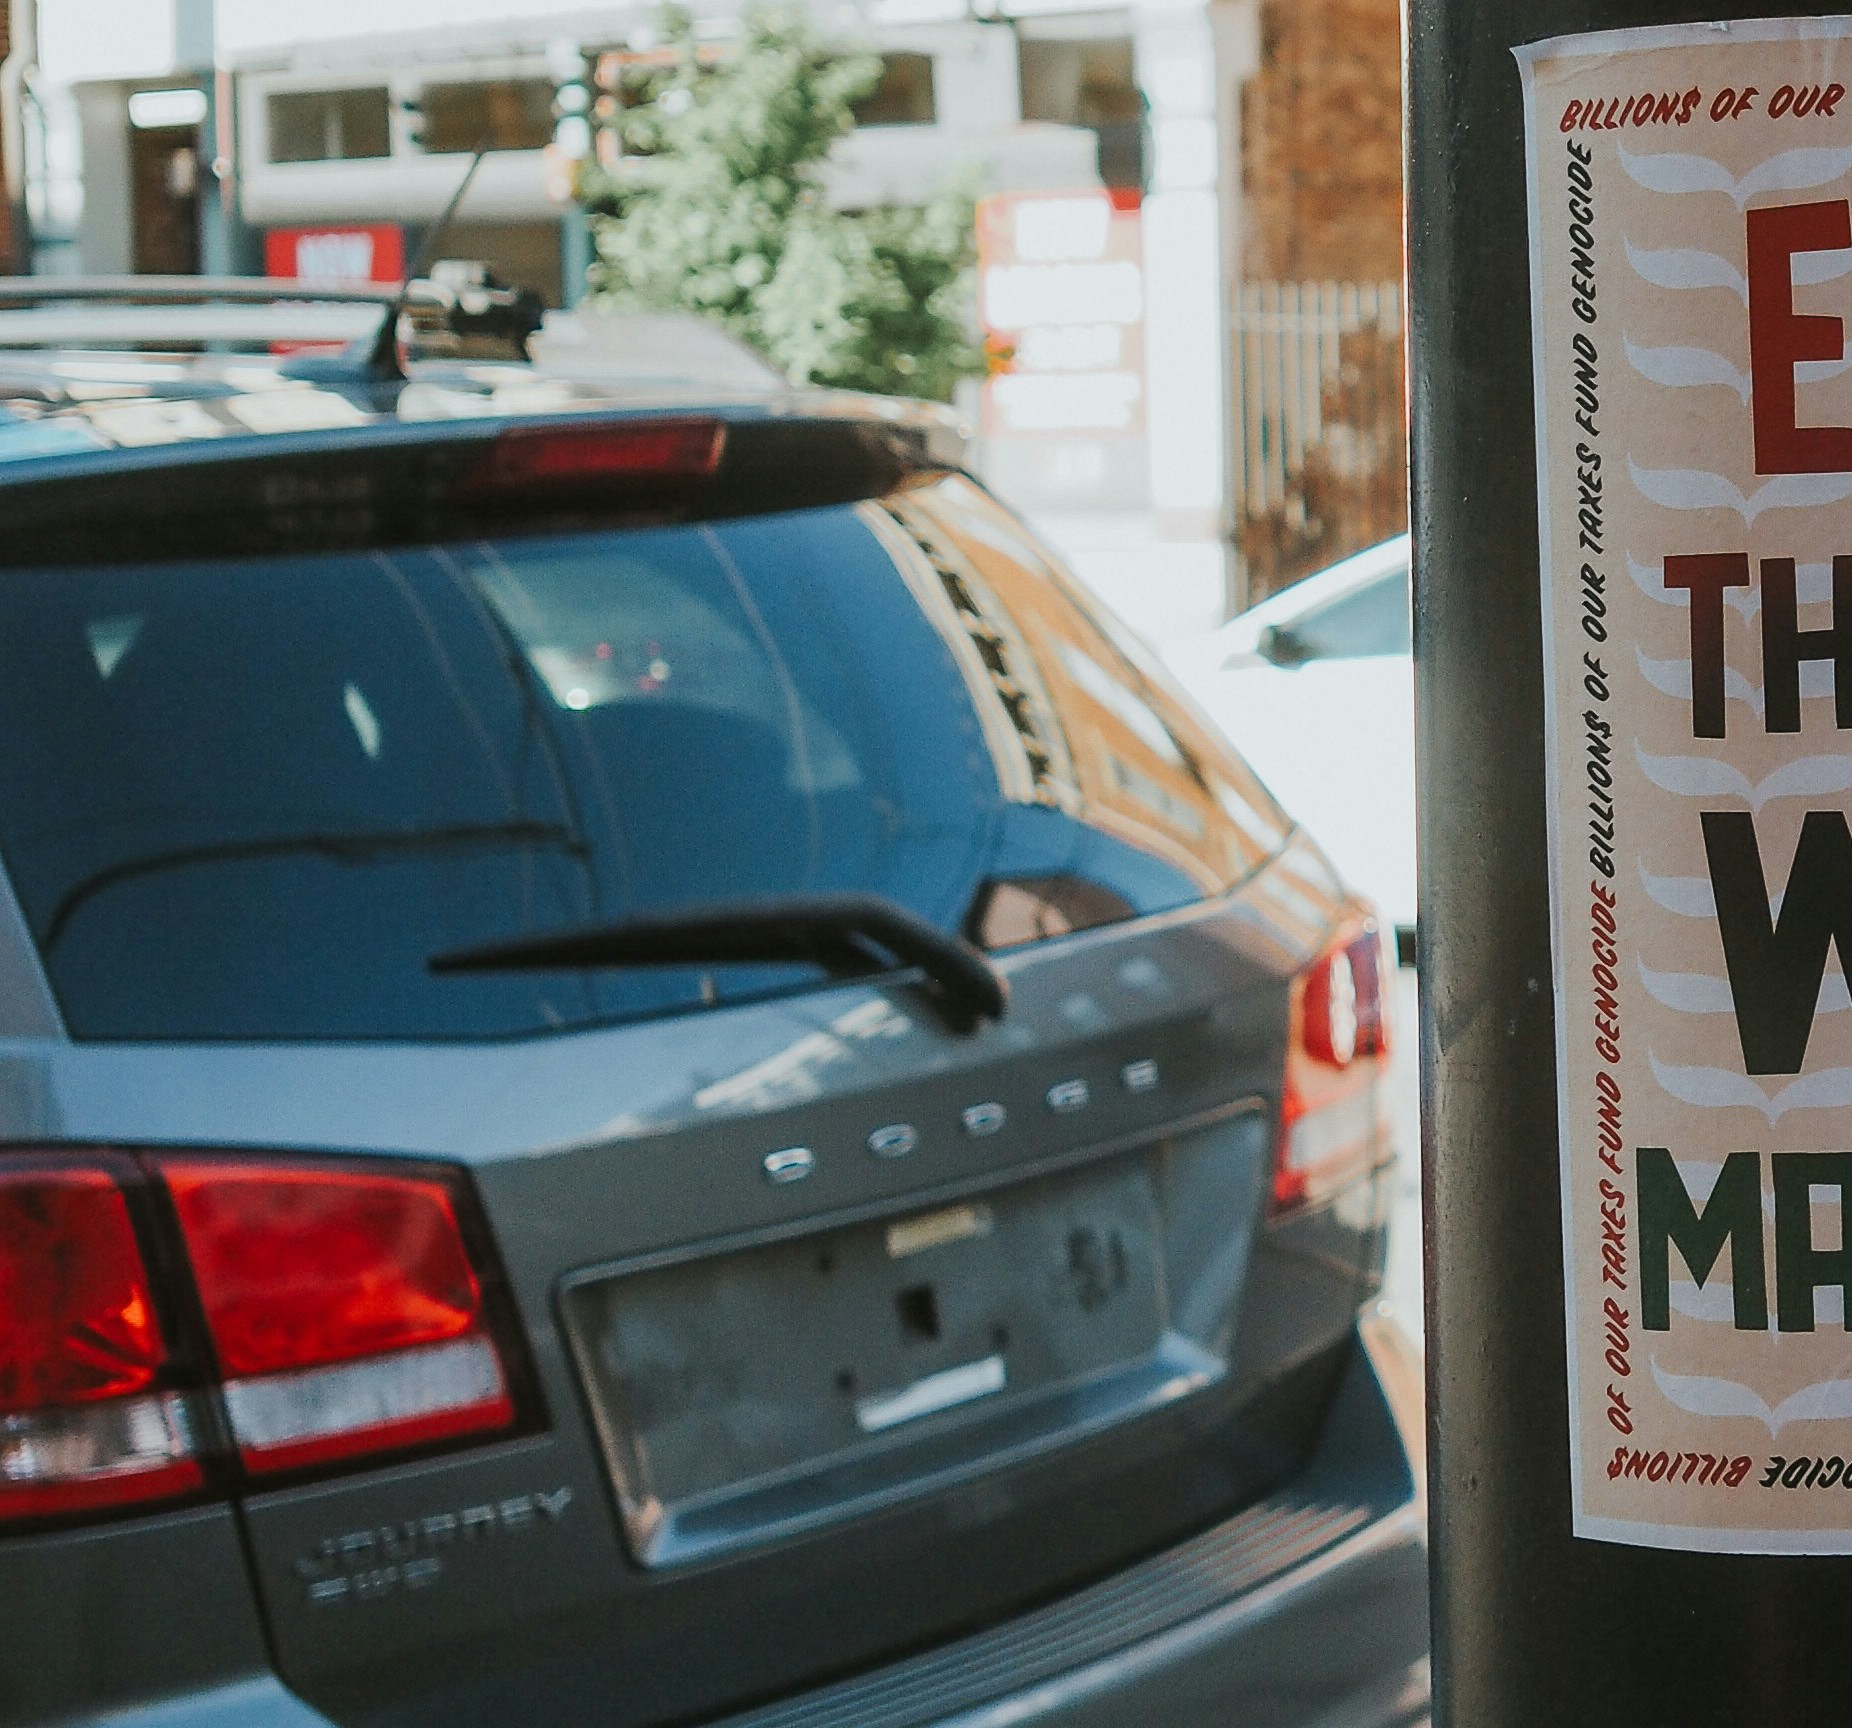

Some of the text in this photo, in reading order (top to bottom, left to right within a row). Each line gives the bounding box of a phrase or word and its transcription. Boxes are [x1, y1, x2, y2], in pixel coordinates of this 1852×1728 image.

[1709, 86, 1759, 123] OF
[1767, 83, 1845, 120] OUR
[1566, 138, 1598, 324] GENOCIDE
[1573, 333, 1600, 437] FUND
[1576, 442, 1604, 554] TAXES
[1580, 562, 1608, 642] OUR
[1584, 651, 1610, 702] OF
[1590, 880, 1622, 1064] GENOCIDE
[763, 1058, 1160, 1184] DODGE
[1595, 1071, 1624, 1175] FUND
[1599, 1178, 1627, 1291] TAXES
[1603, 1297, 1631, 1377] OUR
[1607, 1383, 1633, 1435] OF
